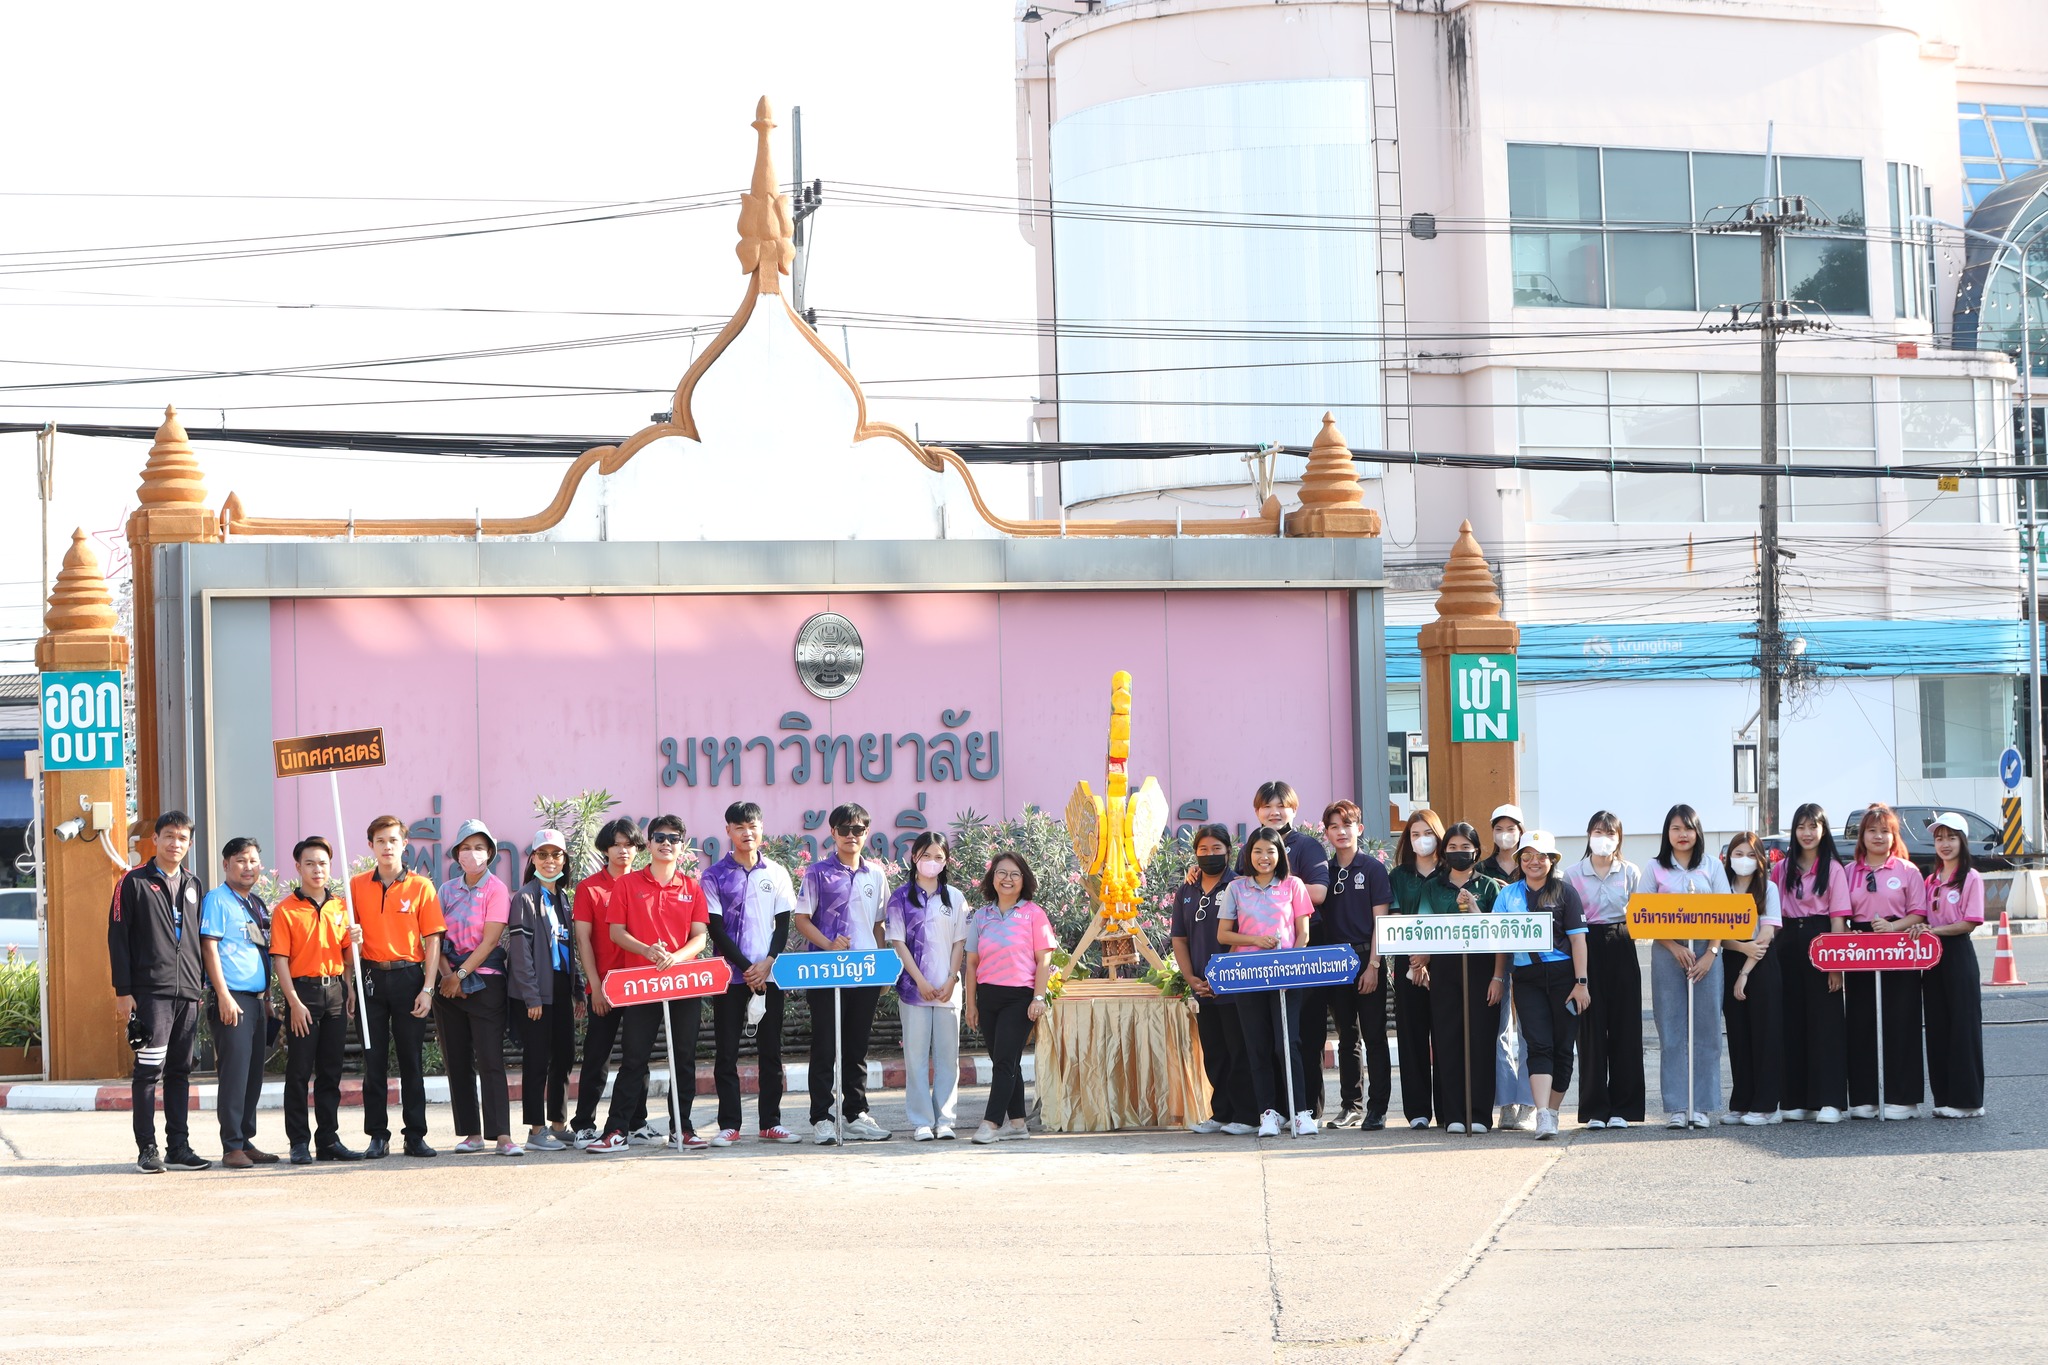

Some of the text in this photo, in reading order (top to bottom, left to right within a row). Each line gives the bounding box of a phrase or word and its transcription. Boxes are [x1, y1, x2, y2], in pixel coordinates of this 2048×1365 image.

[1617, 638, 1682, 654] Krungthai
[1458, 656, 1511, 711] เข้า
[45, 682, 120, 730] ออก
[1463, 712, 1508, 739] IN
[50, 732, 119, 763] OUT
[281, 736, 381, 770] นิเทศศาสตร์
[660, 708, 1000, 787] มหาวิทยาลัย
[1386, 919, 1543, 948] การจัดการธุรกิจดิจิทัล
[1632, 908, 1751, 931] บริหารทรัพยากรมนุษย์
[1818, 938, 1933, 963] การจัดการทั่วไป
[624, 969, 714, 996] การตลาด
[797, 954, 876, 983] การบัญชี
[1219, 955, 1348, 985] การจัดการธุรกิจระหว่างประเทศ
